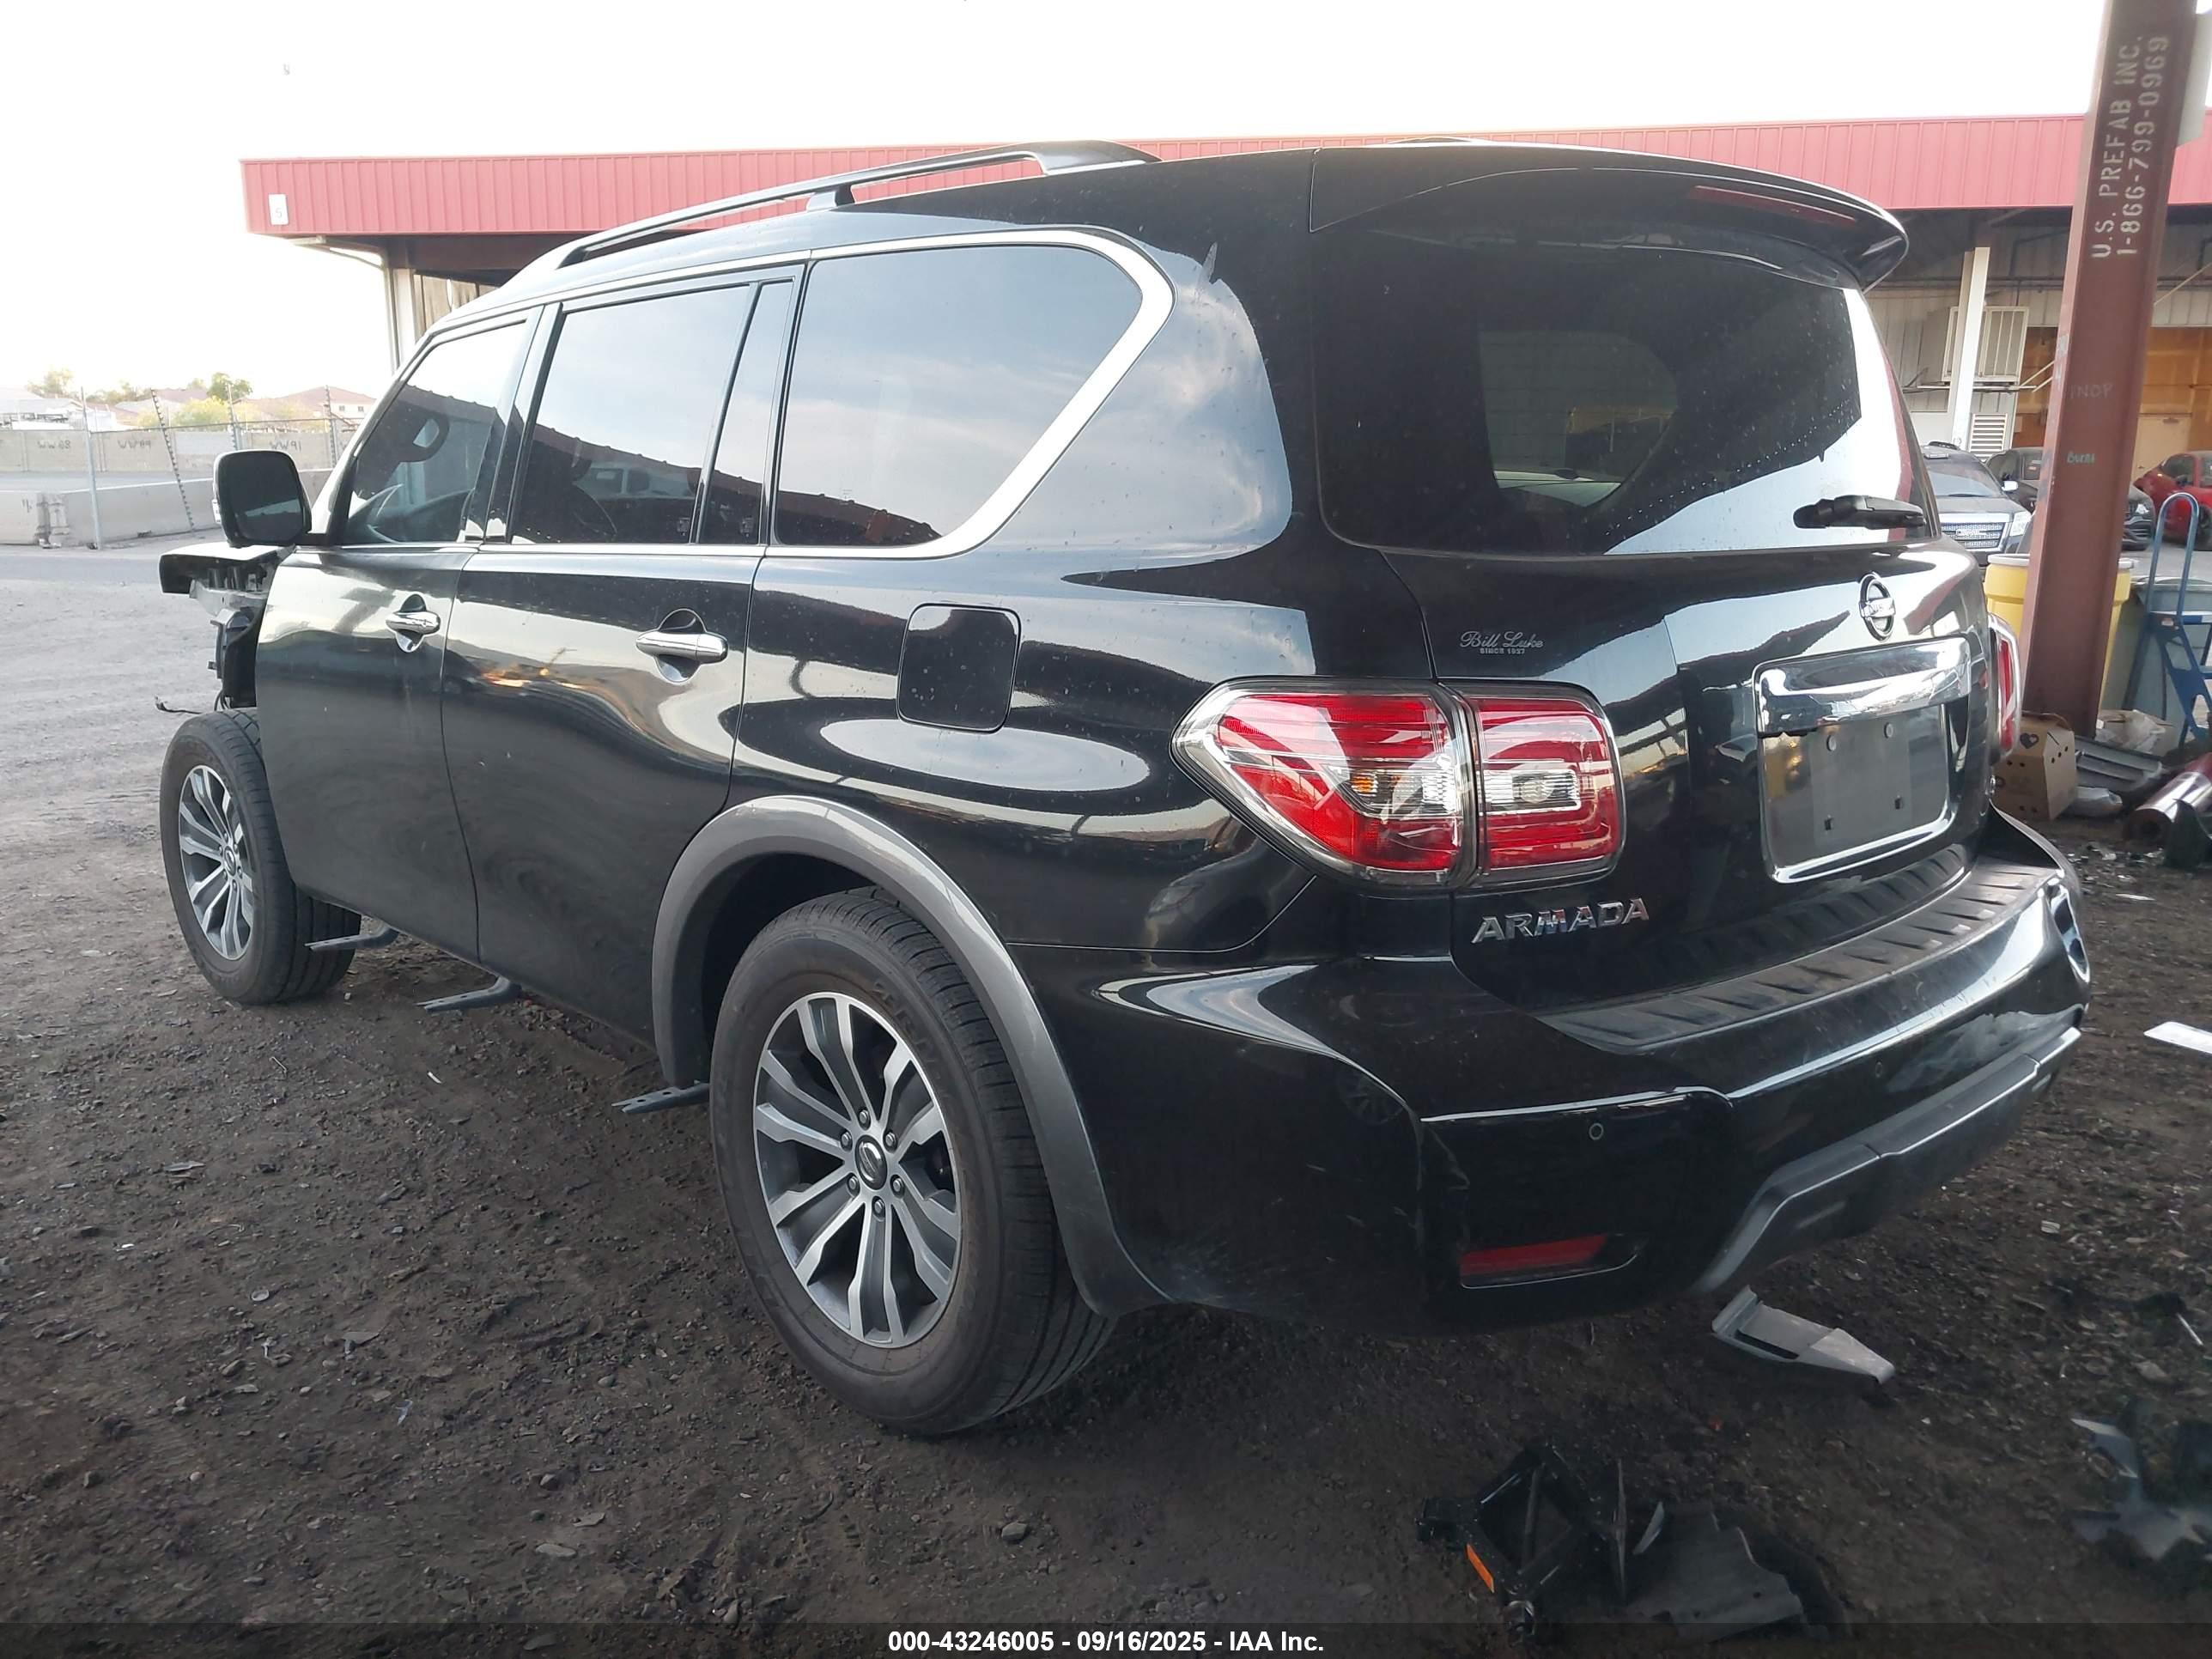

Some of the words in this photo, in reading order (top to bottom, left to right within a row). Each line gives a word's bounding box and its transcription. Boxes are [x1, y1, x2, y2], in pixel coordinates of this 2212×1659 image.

[2114, 36, 2142, 85] INC.
[2099, 99, 2131, 197] PREFAB
[2117, 36, 2170, 255] 1-866-799-0969
[2091, 212, 2116, 258] U.S.
[1460, 631, 1501, 647] Bill
[1471, 897, 1650, 945] ARMADA
